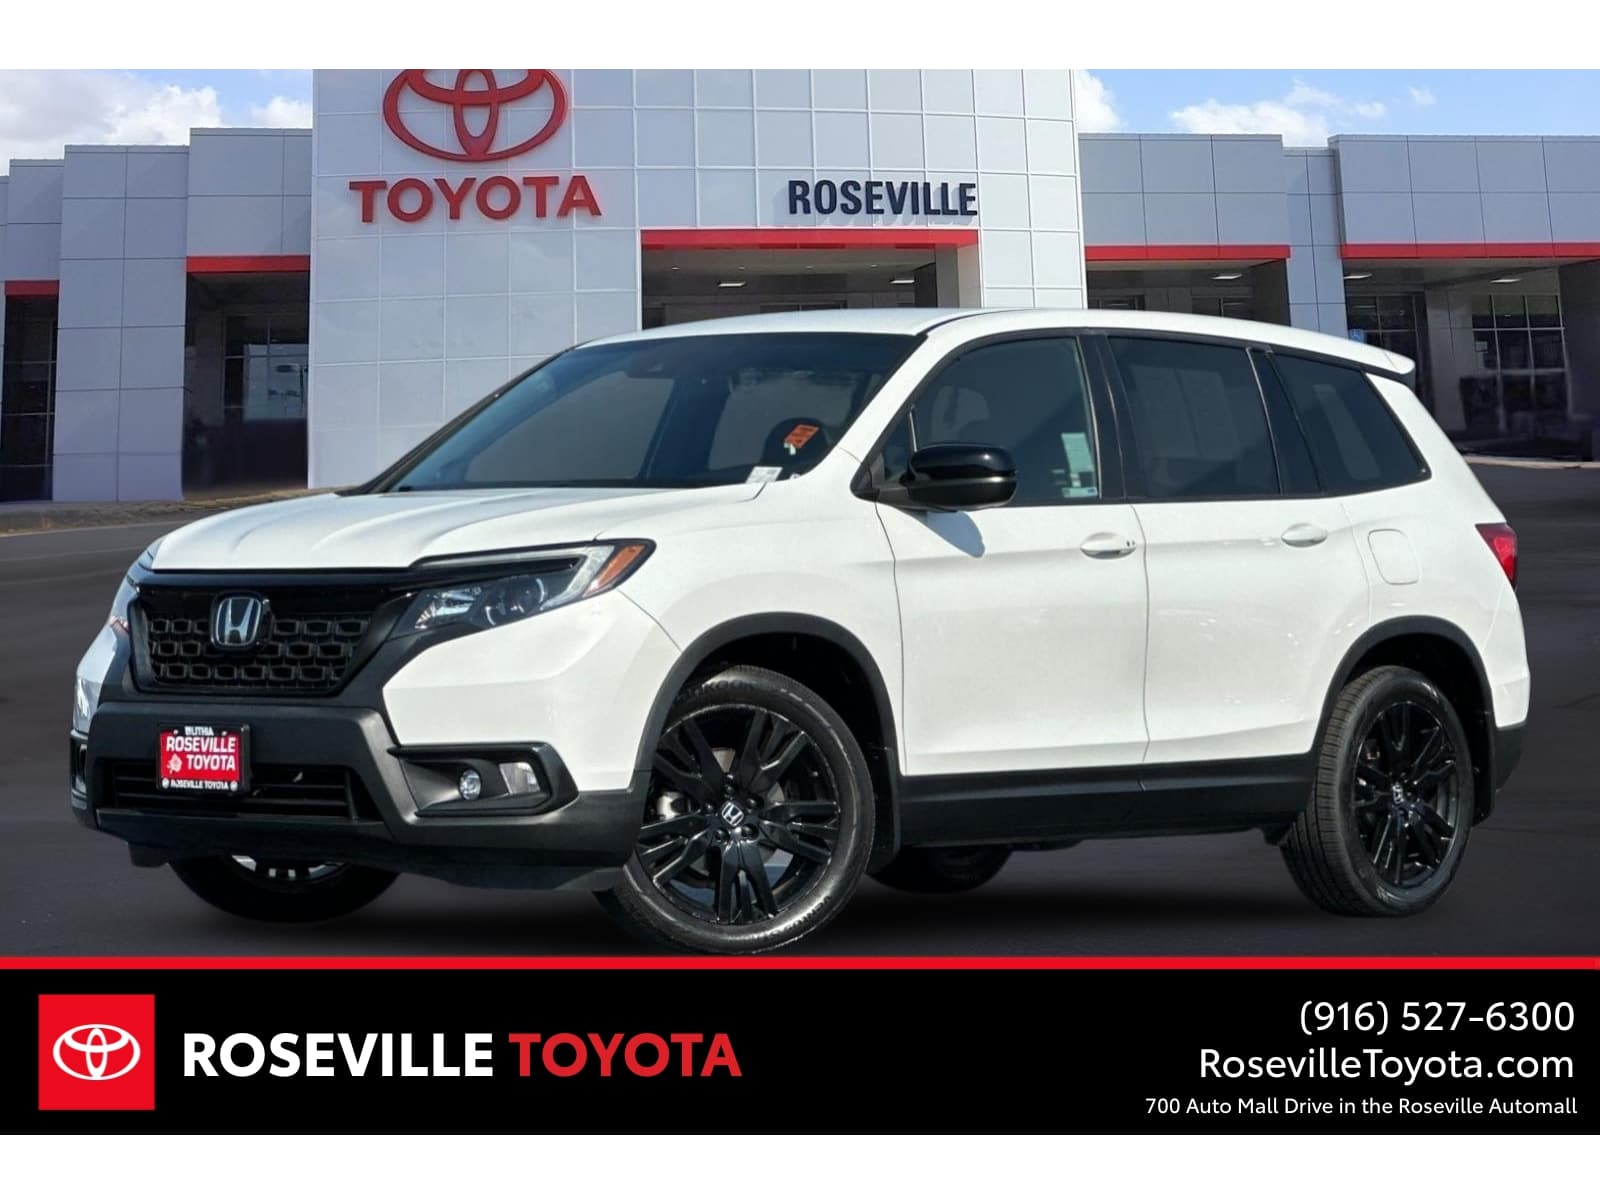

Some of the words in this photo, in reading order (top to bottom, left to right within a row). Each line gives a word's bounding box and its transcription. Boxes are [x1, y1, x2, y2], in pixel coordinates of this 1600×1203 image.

[349, 175, 602, 223] TOYOTA
[788, 179, 979, 217] ROSEVILLE
[165, 736, 237, 753] ROSEVILLE
[186, 754, 236, 771] TOYOTA
[170, 779, 203, 789] ROSEVILLE
[204, 780, 230, 790] TOYOTA
